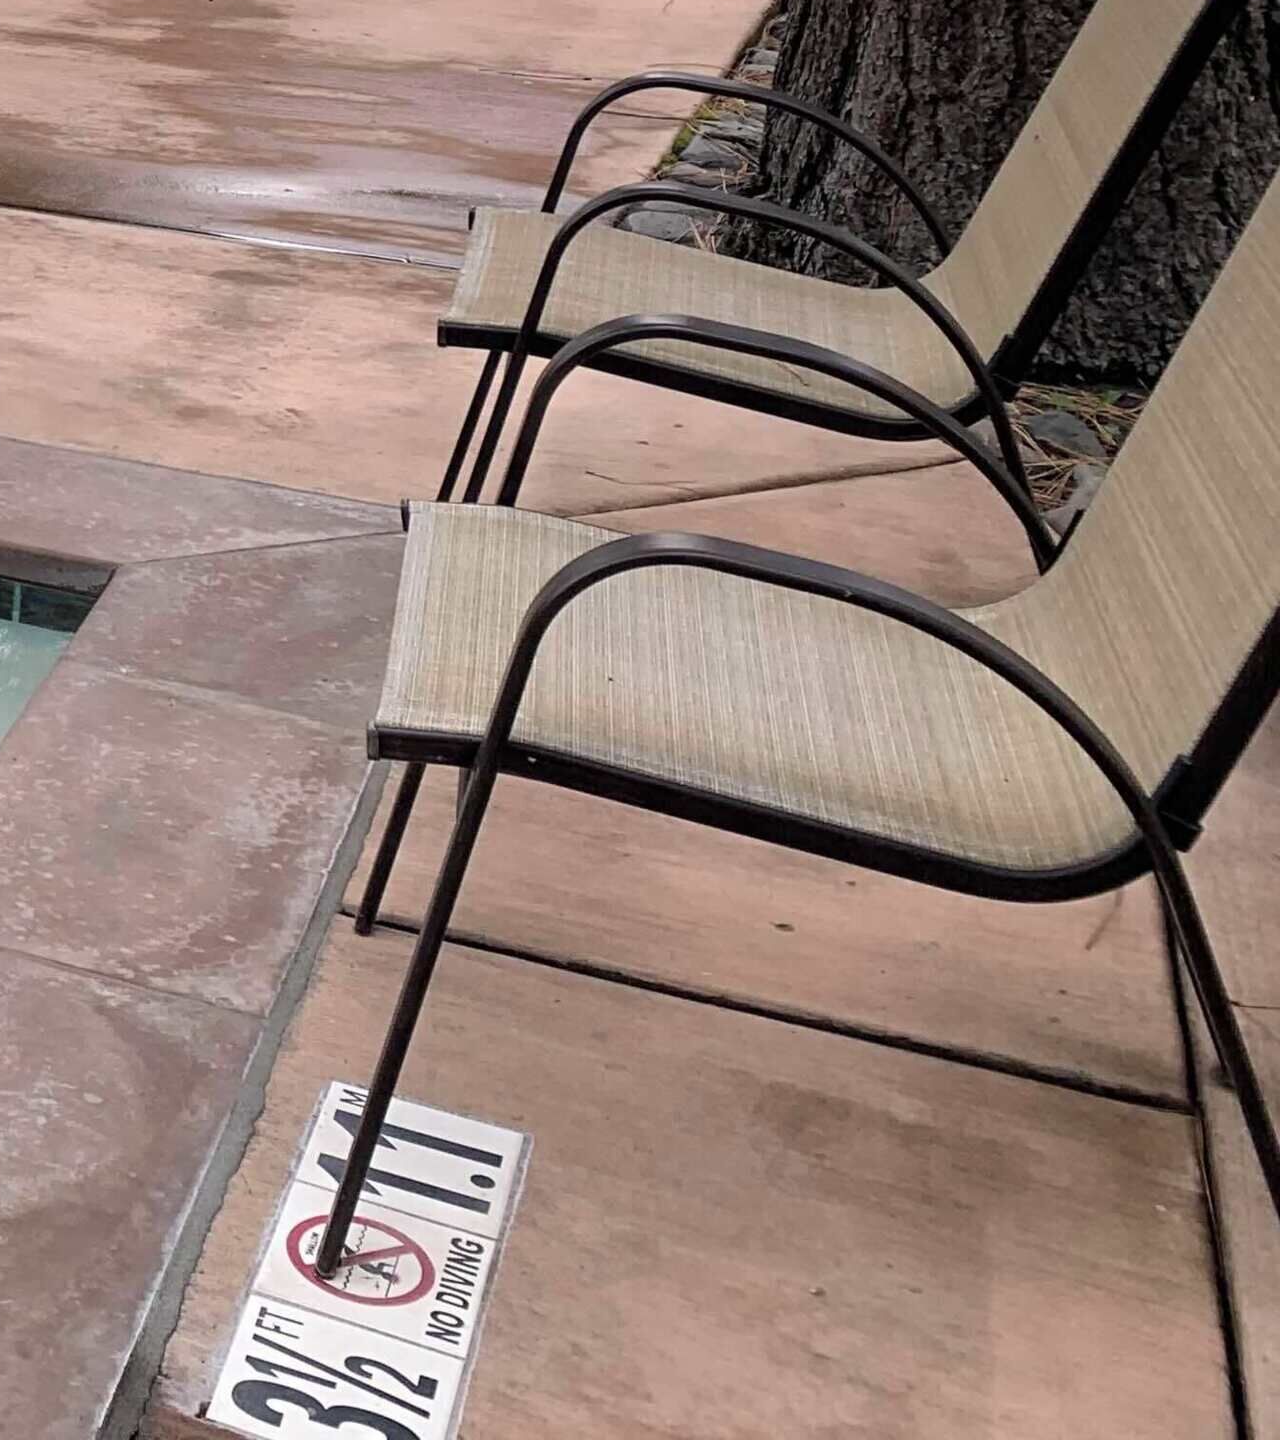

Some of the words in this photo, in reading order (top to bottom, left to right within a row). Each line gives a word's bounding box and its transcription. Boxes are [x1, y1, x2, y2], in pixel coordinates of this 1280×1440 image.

[317, 1109, 504, 1215] 1.1
[435, 1237, 484, 1310] DIVING
[255, 1306, 304, 1340] FT
[425, 1309, 465, 1346] NO
